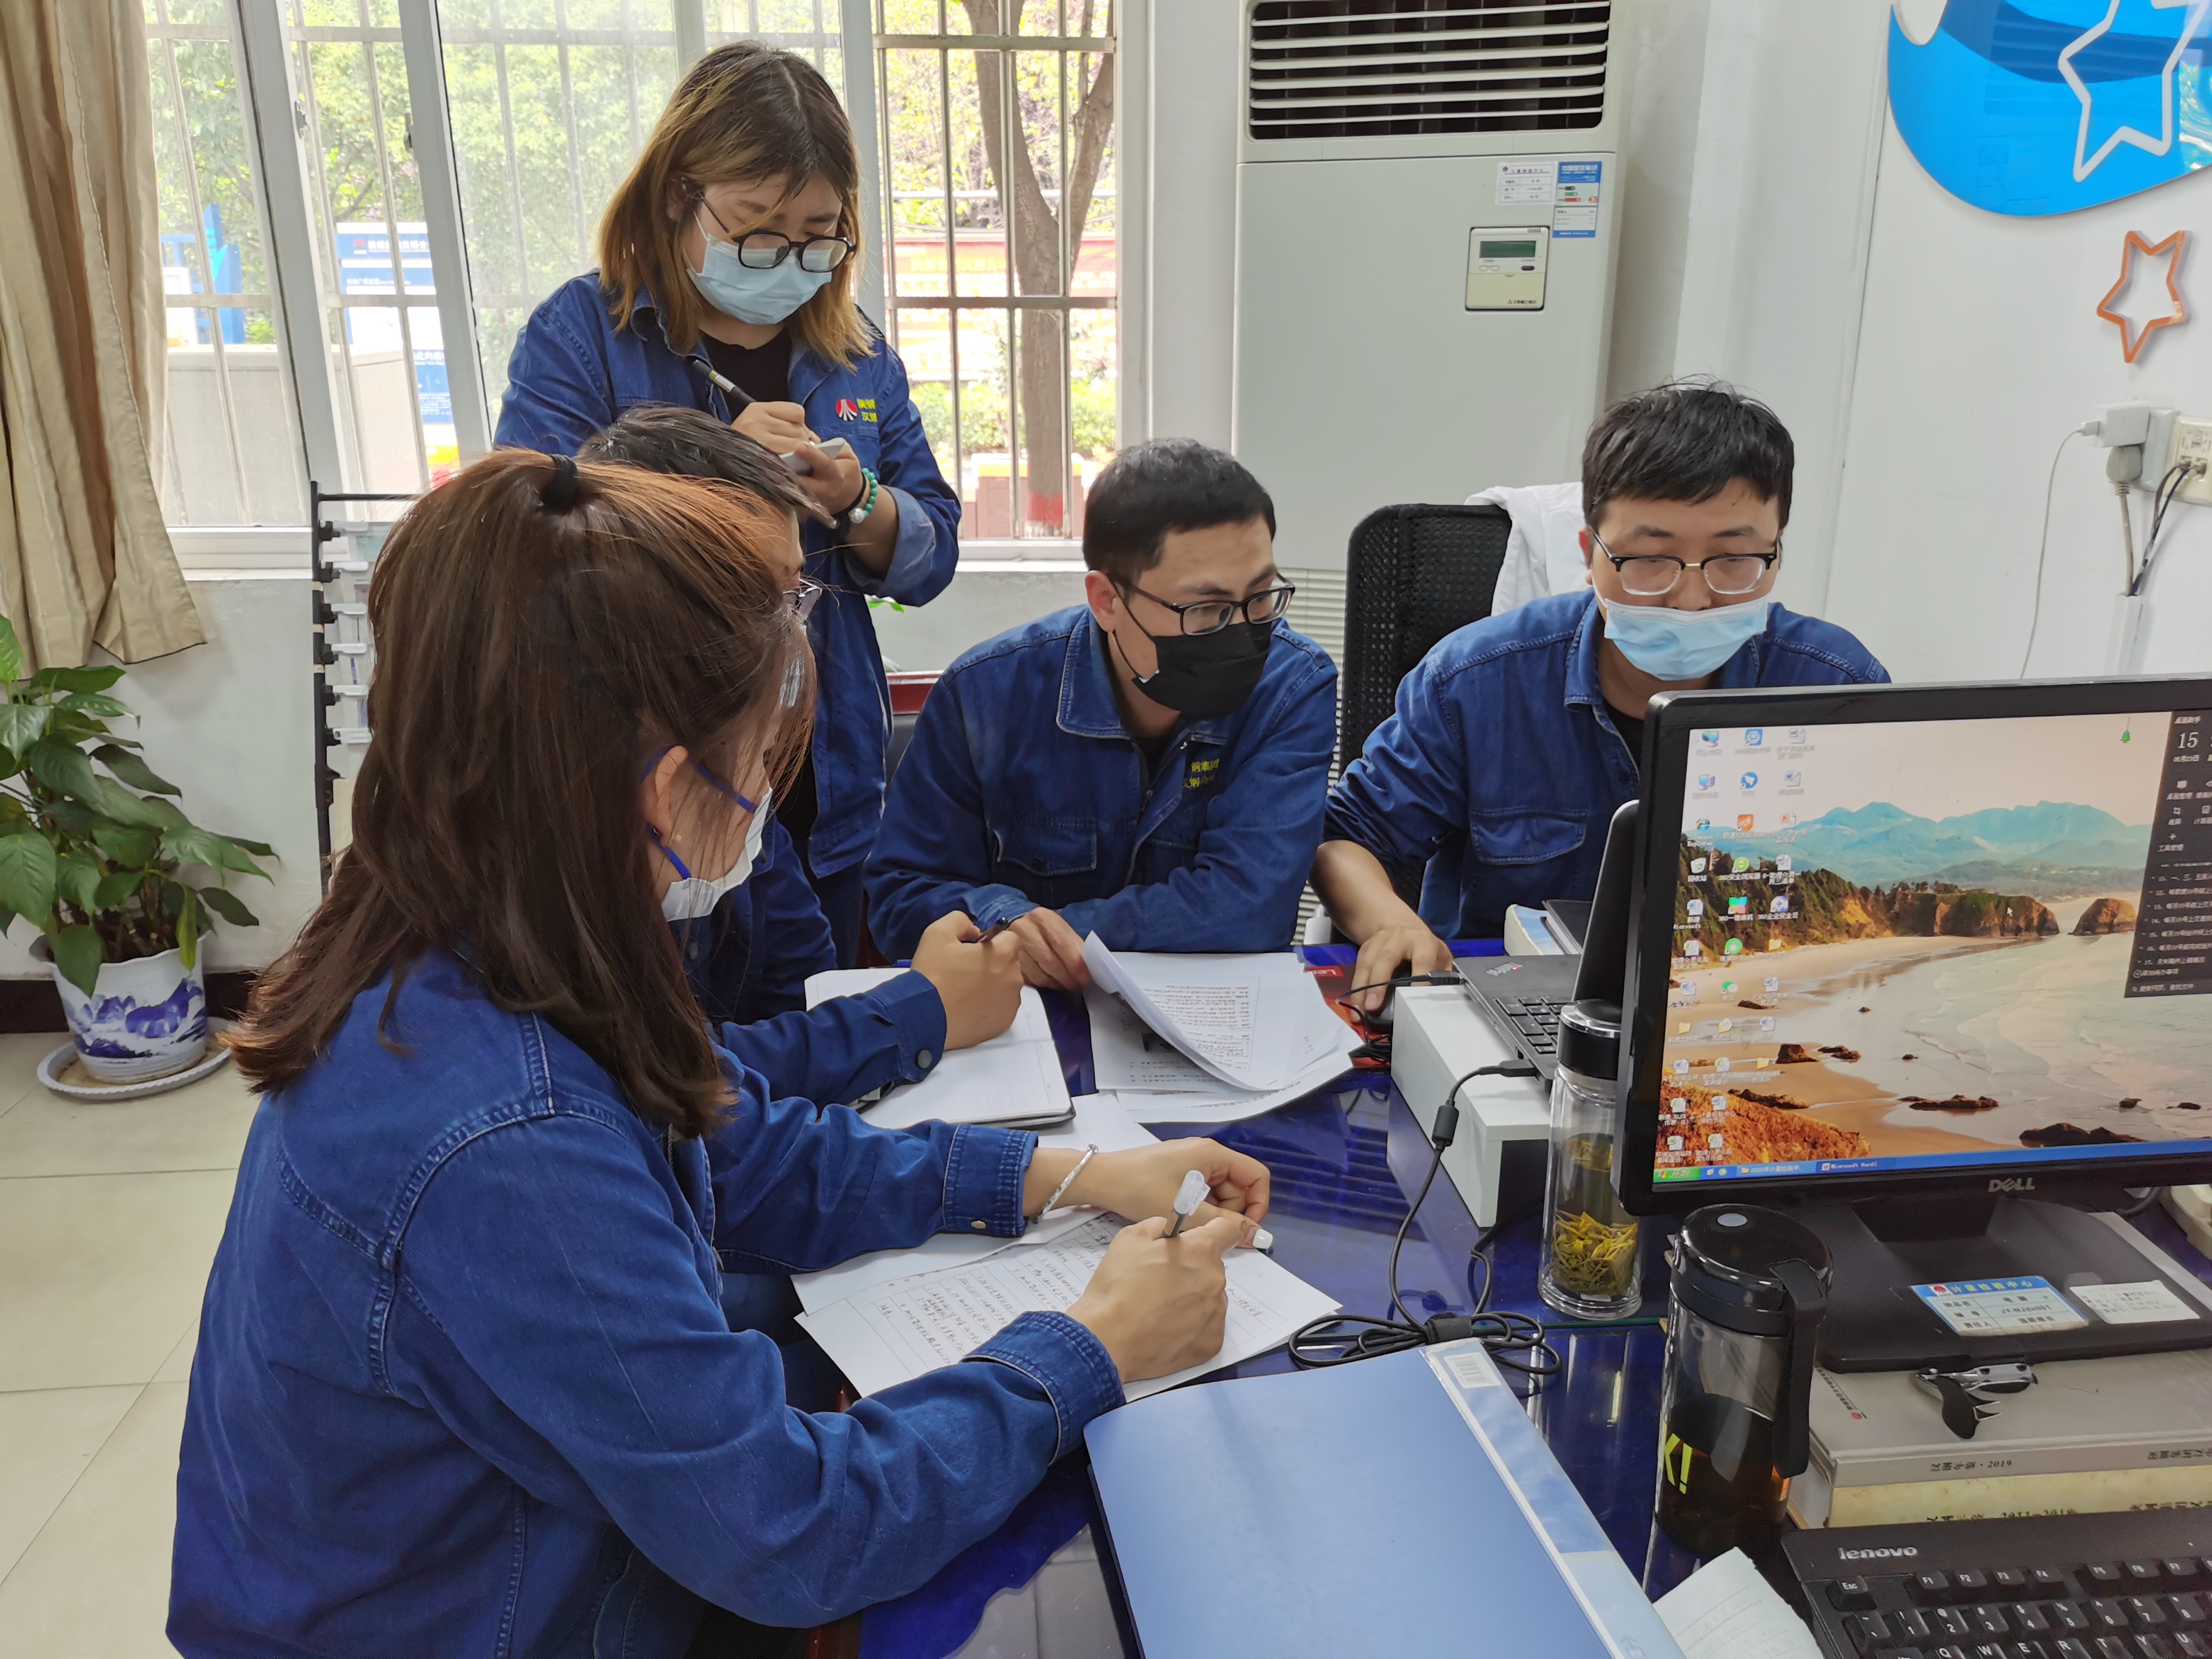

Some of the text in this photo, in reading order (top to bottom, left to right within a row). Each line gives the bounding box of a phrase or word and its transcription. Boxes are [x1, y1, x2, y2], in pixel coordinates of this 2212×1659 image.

[1988, 1177, 2036, 1193] DELL
[1839, 1547, 1918, 1560] lenovo
[1937, 1608, 1948, 1617] @
[1946, 1623, 1956, 1633] 2
[1985, 1621, 1995, 1632] 3
[2027, 1619, 2035, 1628] 4
[2066, 1617, 2076, 1627] 5
[2105, 1615, 2114, 1624] 6
[2142, 1612, 2151, 1622] 7
[2181, 1609, 2191, 1618] 8
[1939, 1634, 2189, 1658] Q W E R T Y U
